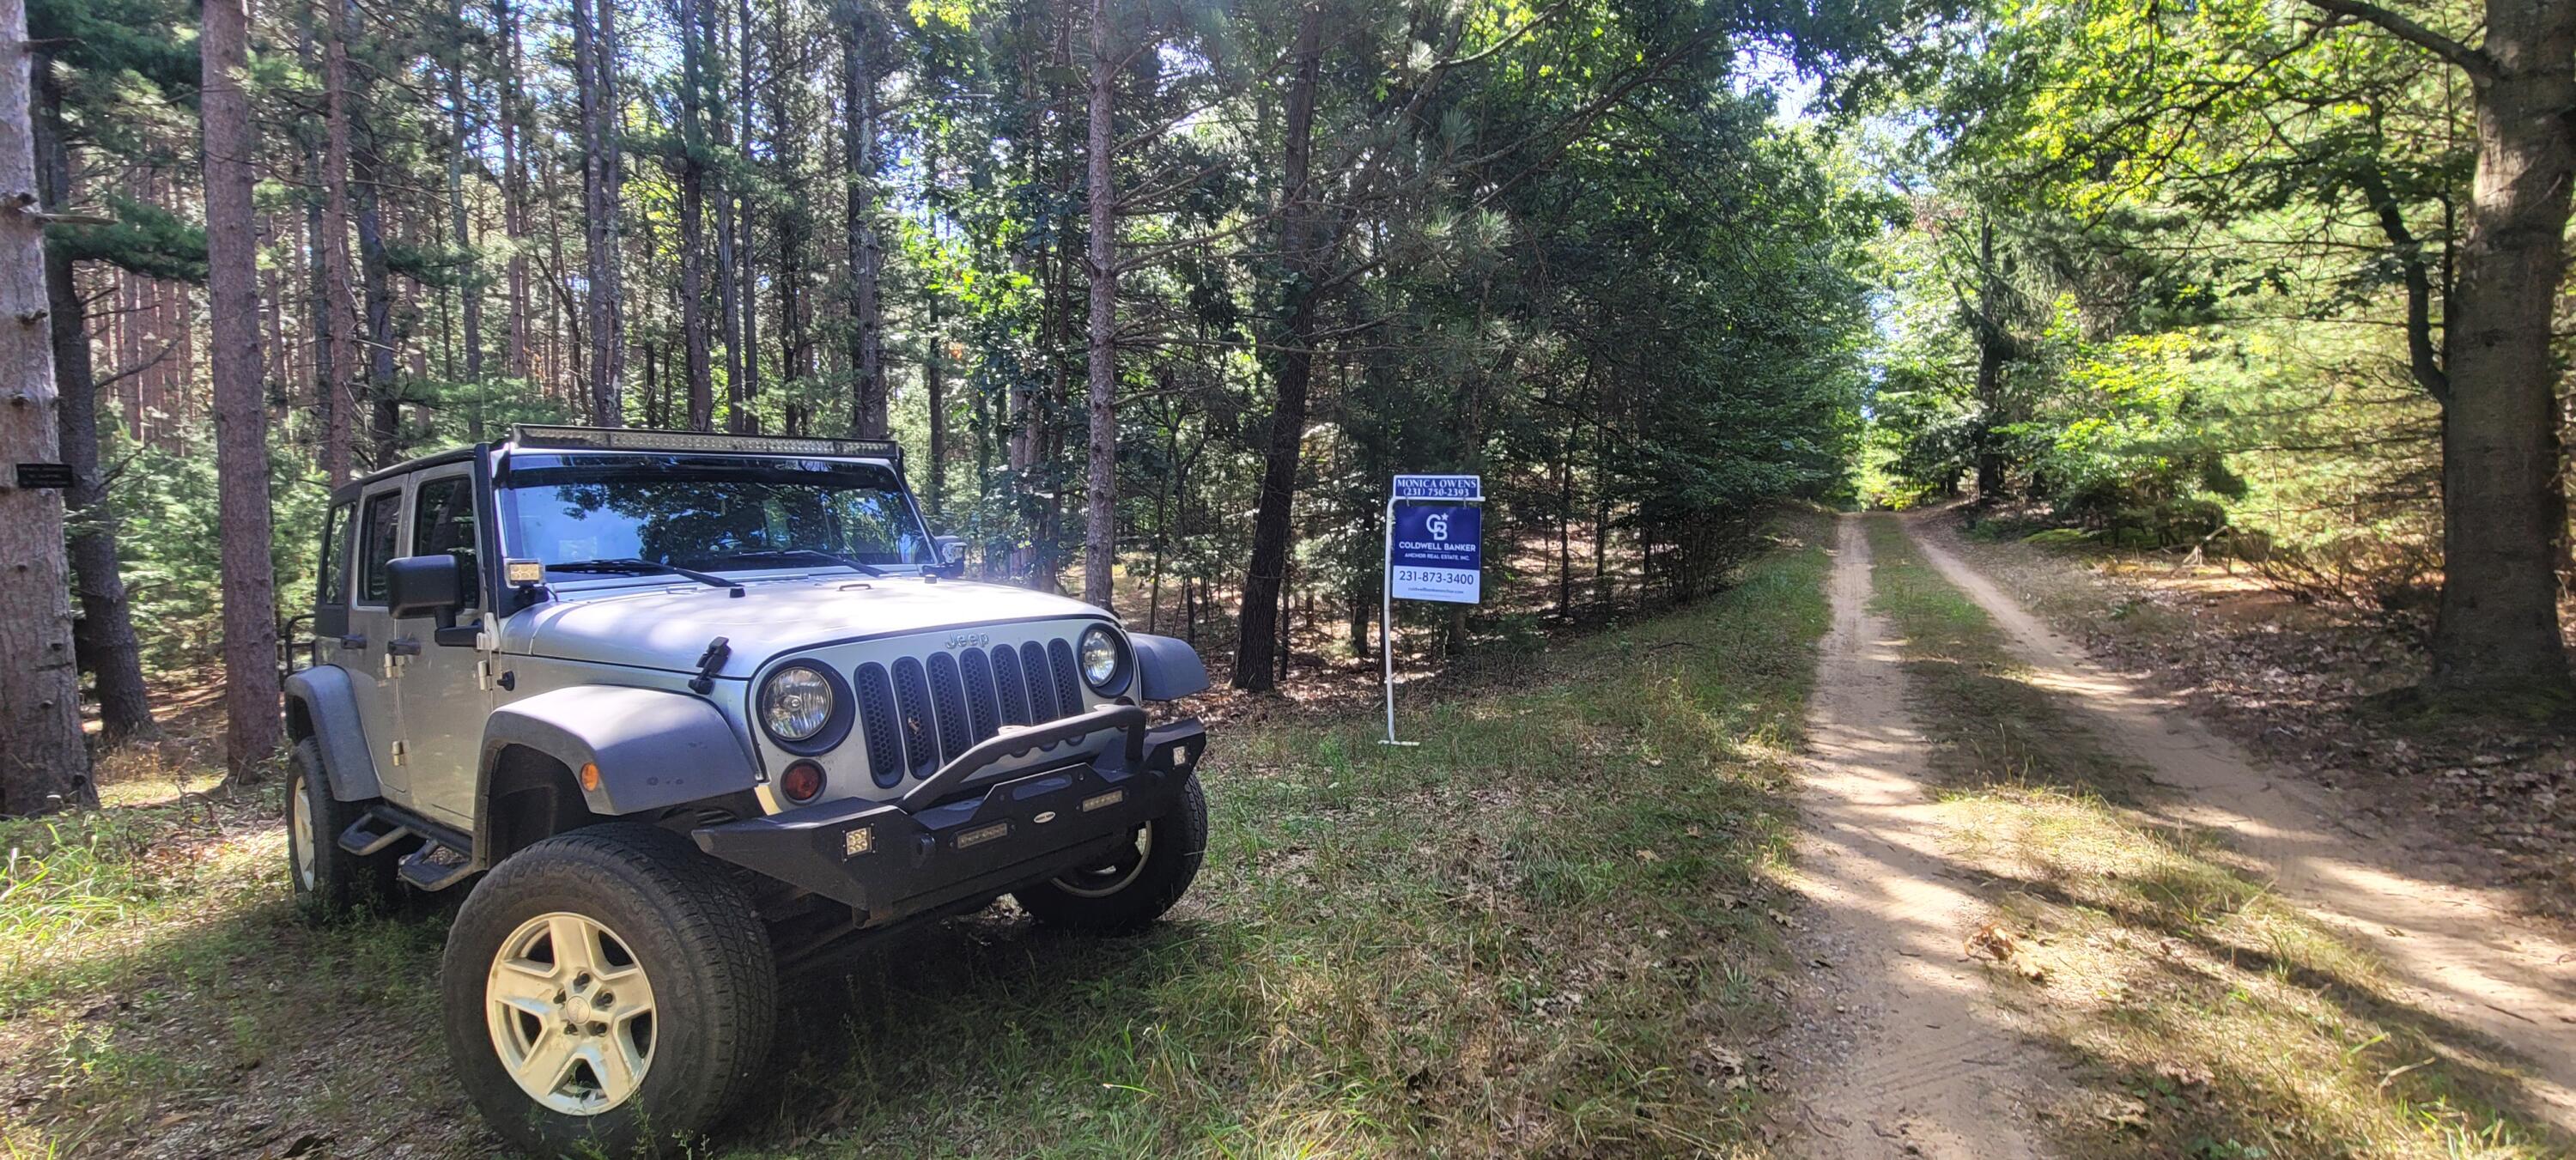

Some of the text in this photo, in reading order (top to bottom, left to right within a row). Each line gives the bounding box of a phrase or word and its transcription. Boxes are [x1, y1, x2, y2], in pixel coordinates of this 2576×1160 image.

[1397, 479, 1477, 489] MONICA OWENS
[1403, 487, 1469, 497] (231) 750-2393
[1399, 541, 1476, 552] COLDWELL BANKER
[1399, 570, 1474, 586] 231-873-3400
[945, 632, 989, 649] Jeep
